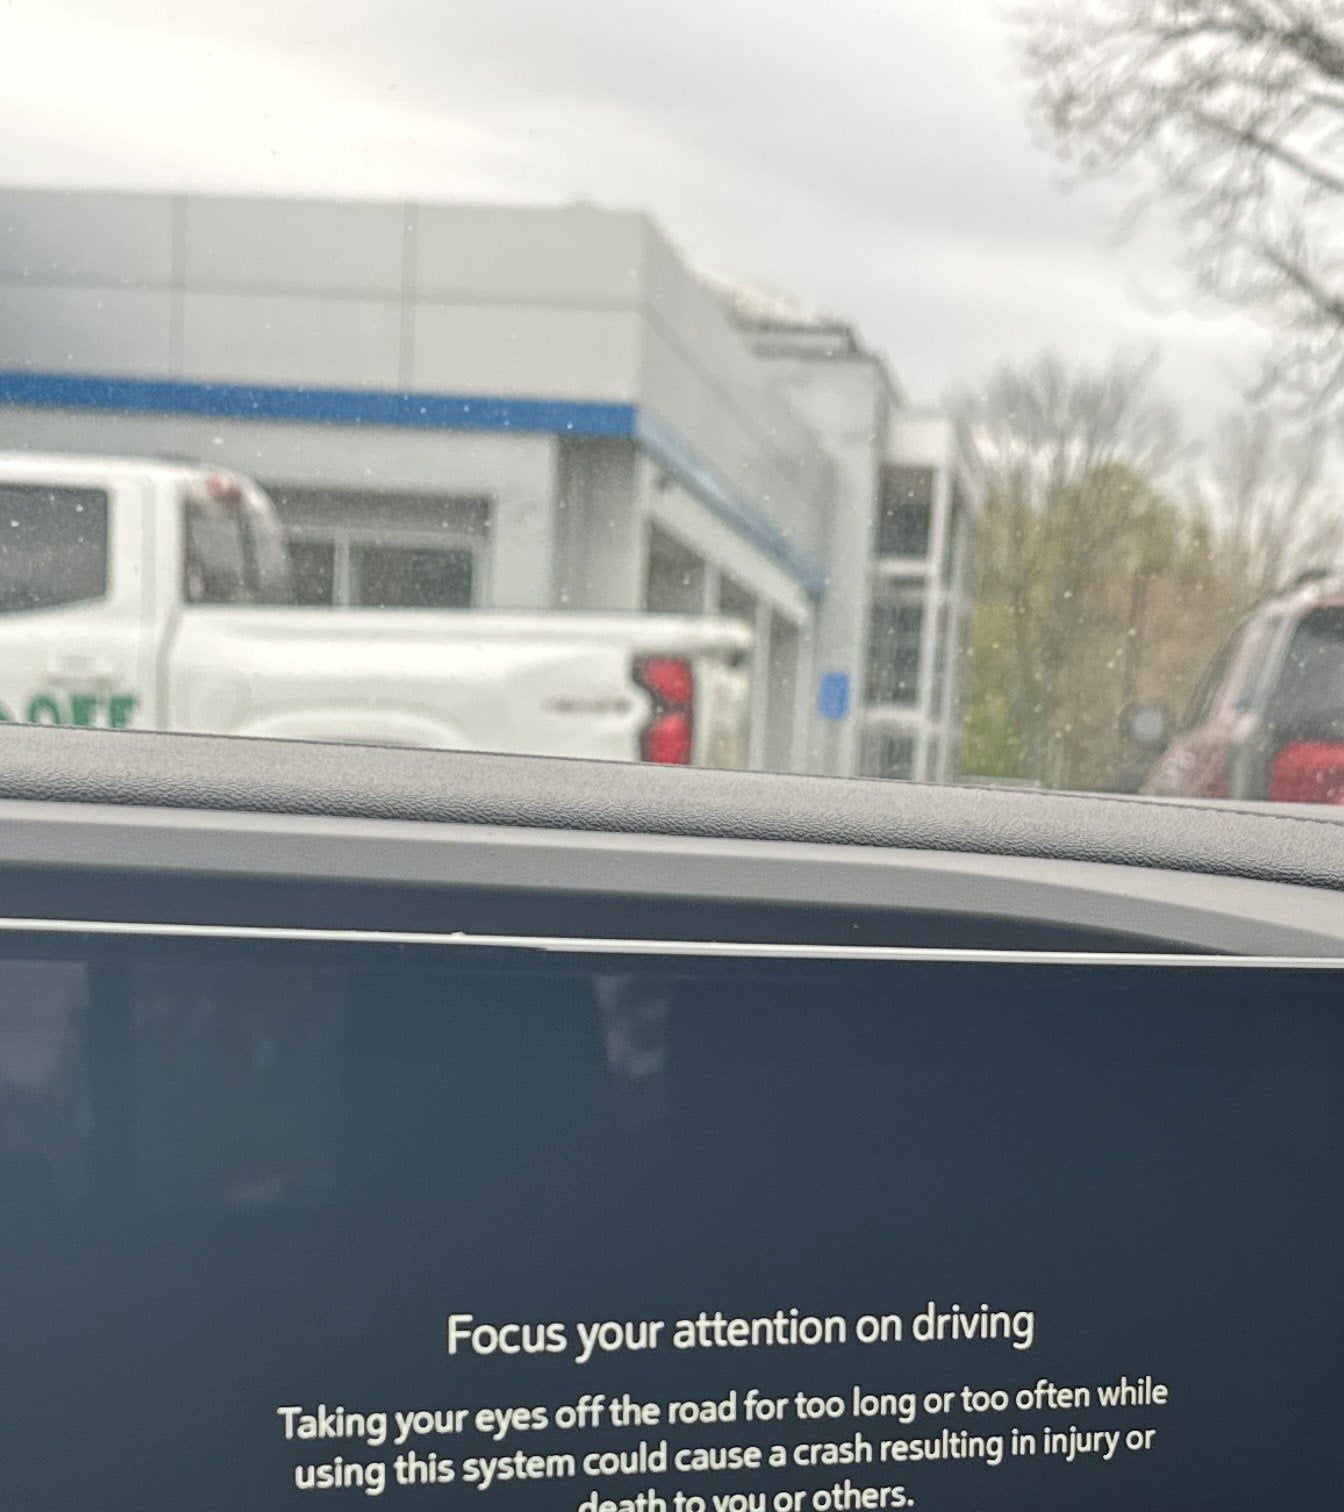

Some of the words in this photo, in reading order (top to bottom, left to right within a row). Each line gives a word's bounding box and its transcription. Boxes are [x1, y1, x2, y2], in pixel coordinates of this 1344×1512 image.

[446, 1313, 569, 1356] Focus
[574, 1319, 665, 1365] your
[672, 1307, 847, 1350] attention
[855, 1314, 903, 1345] on
[911, 1300, 1036, 1352] driving
[276, 1403, 388, 1448] Taking
[393, 1408, 470, 1447] your
[473, 1405, 550, 1443] eyes
[554, 1393, 607, 1431] off
[607, 1393, 661, 1428] the
[668, 1388, 738, 1426] road
[742, 1387, 791, 1422] for
[793, 1390, 847, 1422] too
[852, 1384, 918, 1425] long
[923, 1391, 957, 1416] or
[958, 1384, 1012, 1414] too
[1014, 1377, 1092, 1412] often
[1095, 1373, 1170, 1409] while
[293, 1454, 387, 1498] using
[391, 1448, 457, 1488] this
[461, 1448, 577, 1492] system
[581, 1438, 669, 1478] could
[673, 1443, 763, 1474] cause
[768, 1443, 788, 1470] a
[792, 1430, 874, 1469] crash
[879, 1426, 1005, 1468] resulting
[1010, 1426, 1037, 1457] in
[1042, 1423, 1122, 1463] injury
[1124, 1427, 1157, 1452] or
